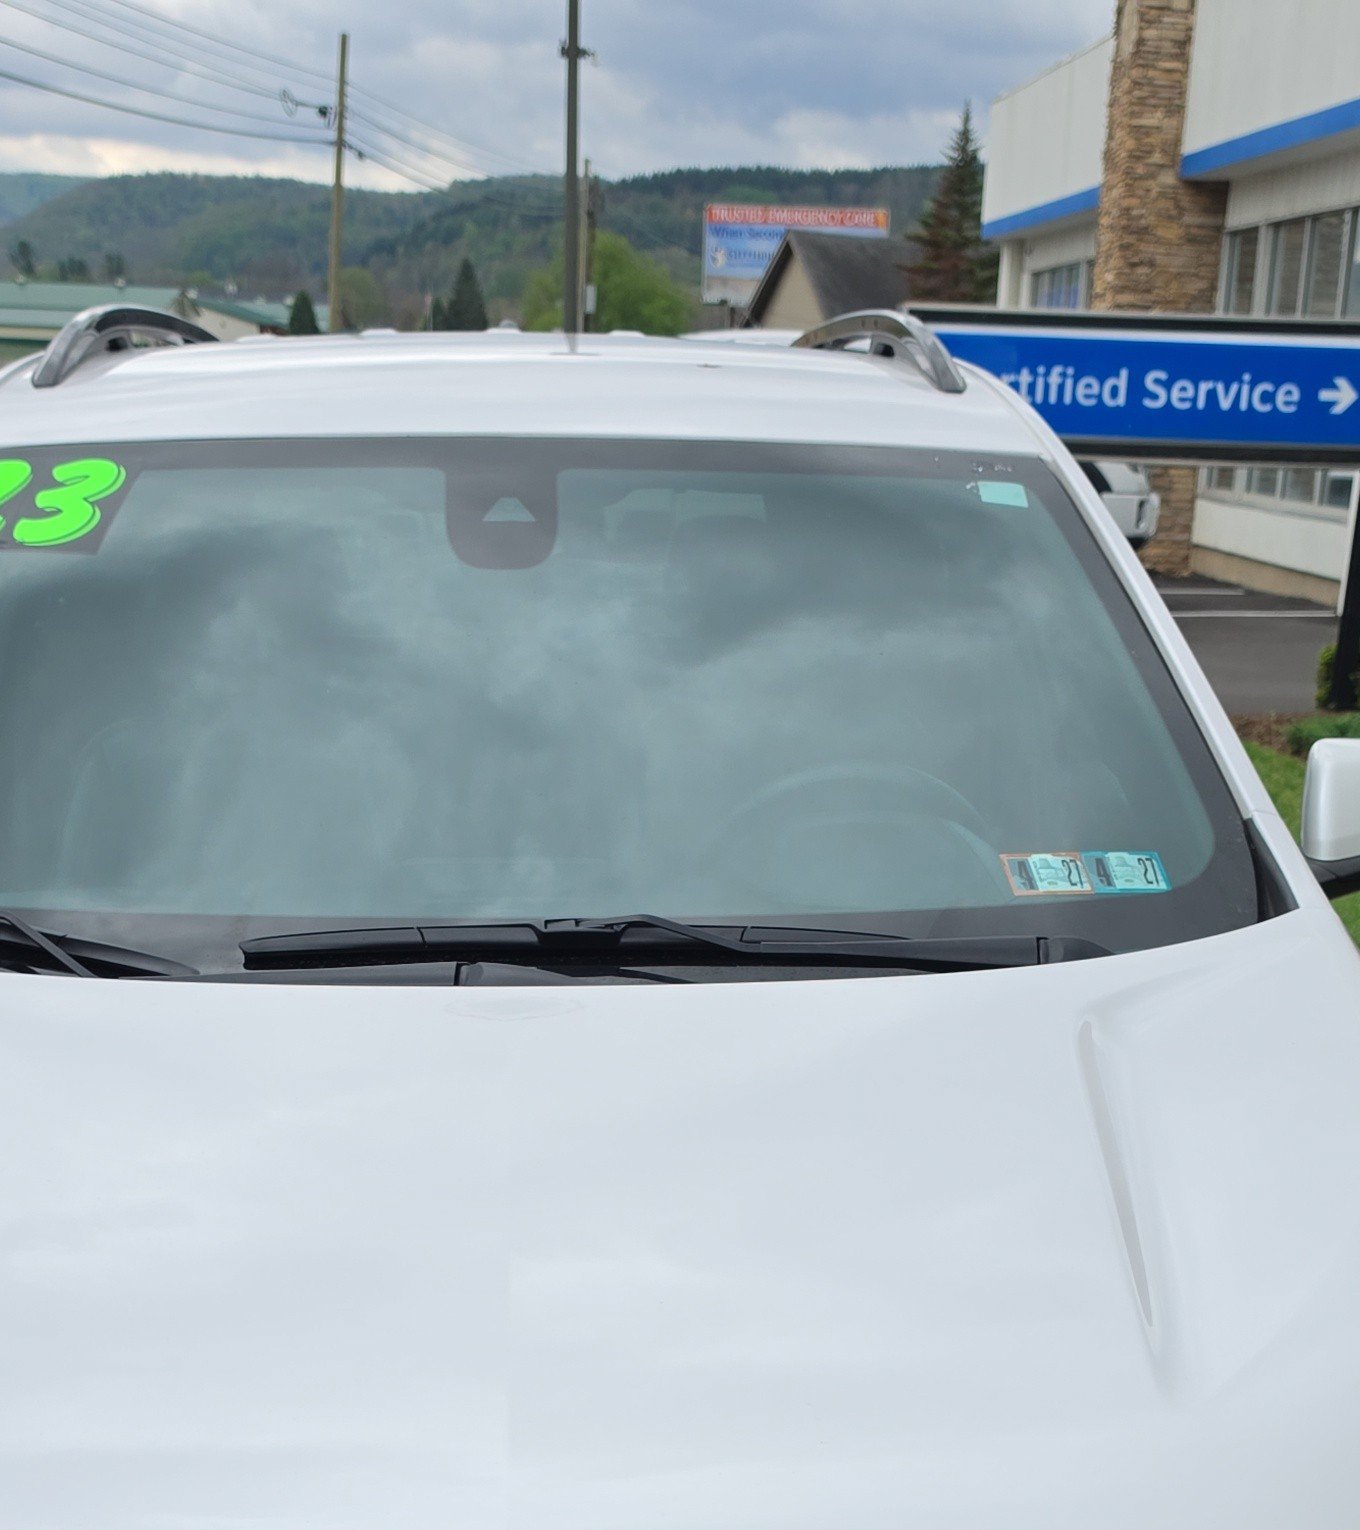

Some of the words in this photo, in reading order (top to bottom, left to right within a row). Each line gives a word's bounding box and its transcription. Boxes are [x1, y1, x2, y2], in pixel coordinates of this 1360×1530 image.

[768, 209, 842, 226] EMERGENCY
[1142, 369, 1301, 413] Service
[1061, 859, 1084, 888] 27
[1137, 857, 1159, 886] 27
